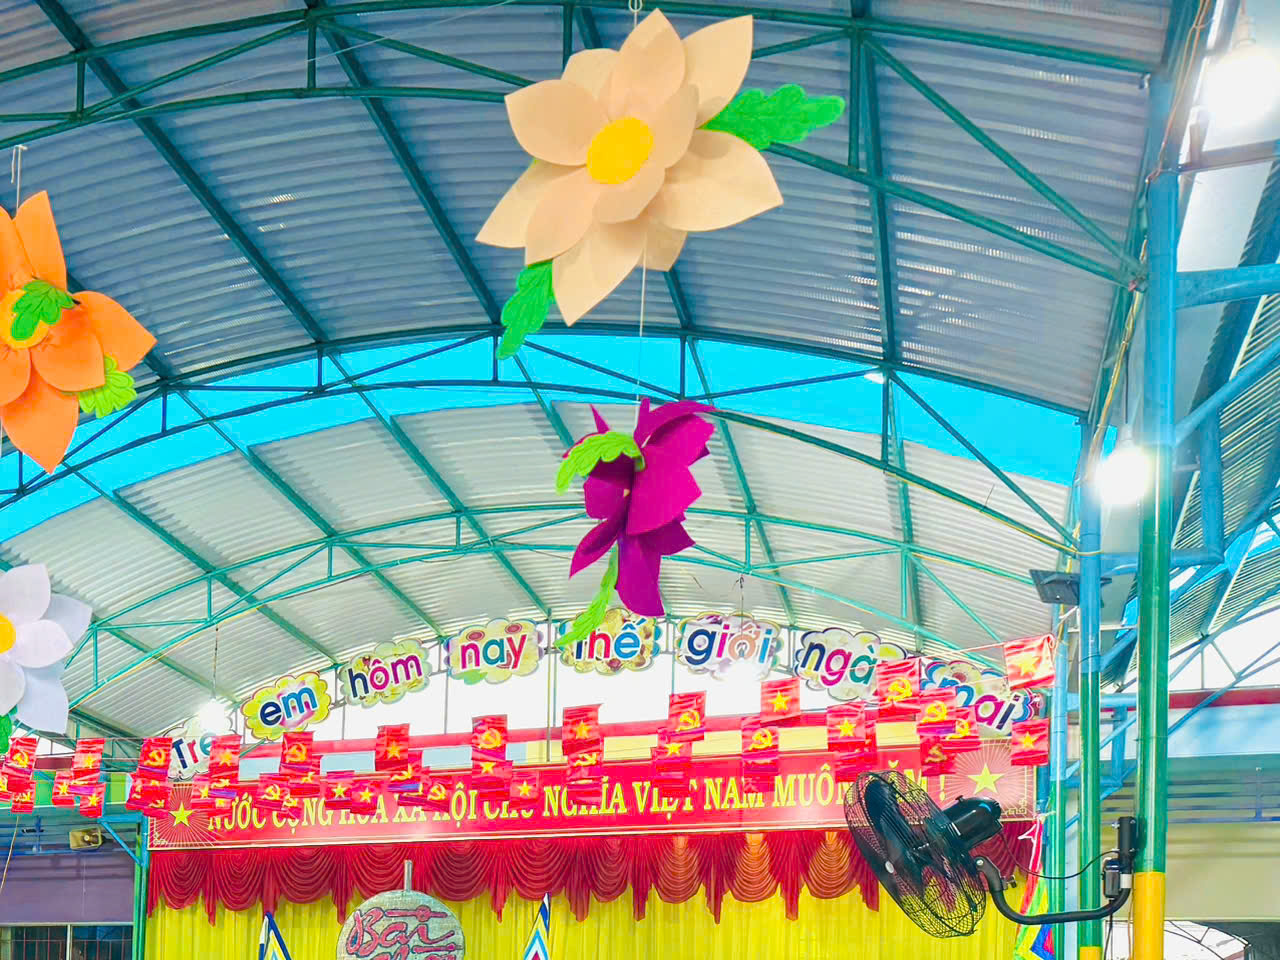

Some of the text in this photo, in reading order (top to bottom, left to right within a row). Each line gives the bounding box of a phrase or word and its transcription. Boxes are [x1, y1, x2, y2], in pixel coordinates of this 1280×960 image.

[259, 687, 318, 726] em
[348, 653, 423, 698] hôm
[460, 633, 527, 669] nay
[687, 624, 773, 666] giới
[801, 642, 878, 686] ngà
